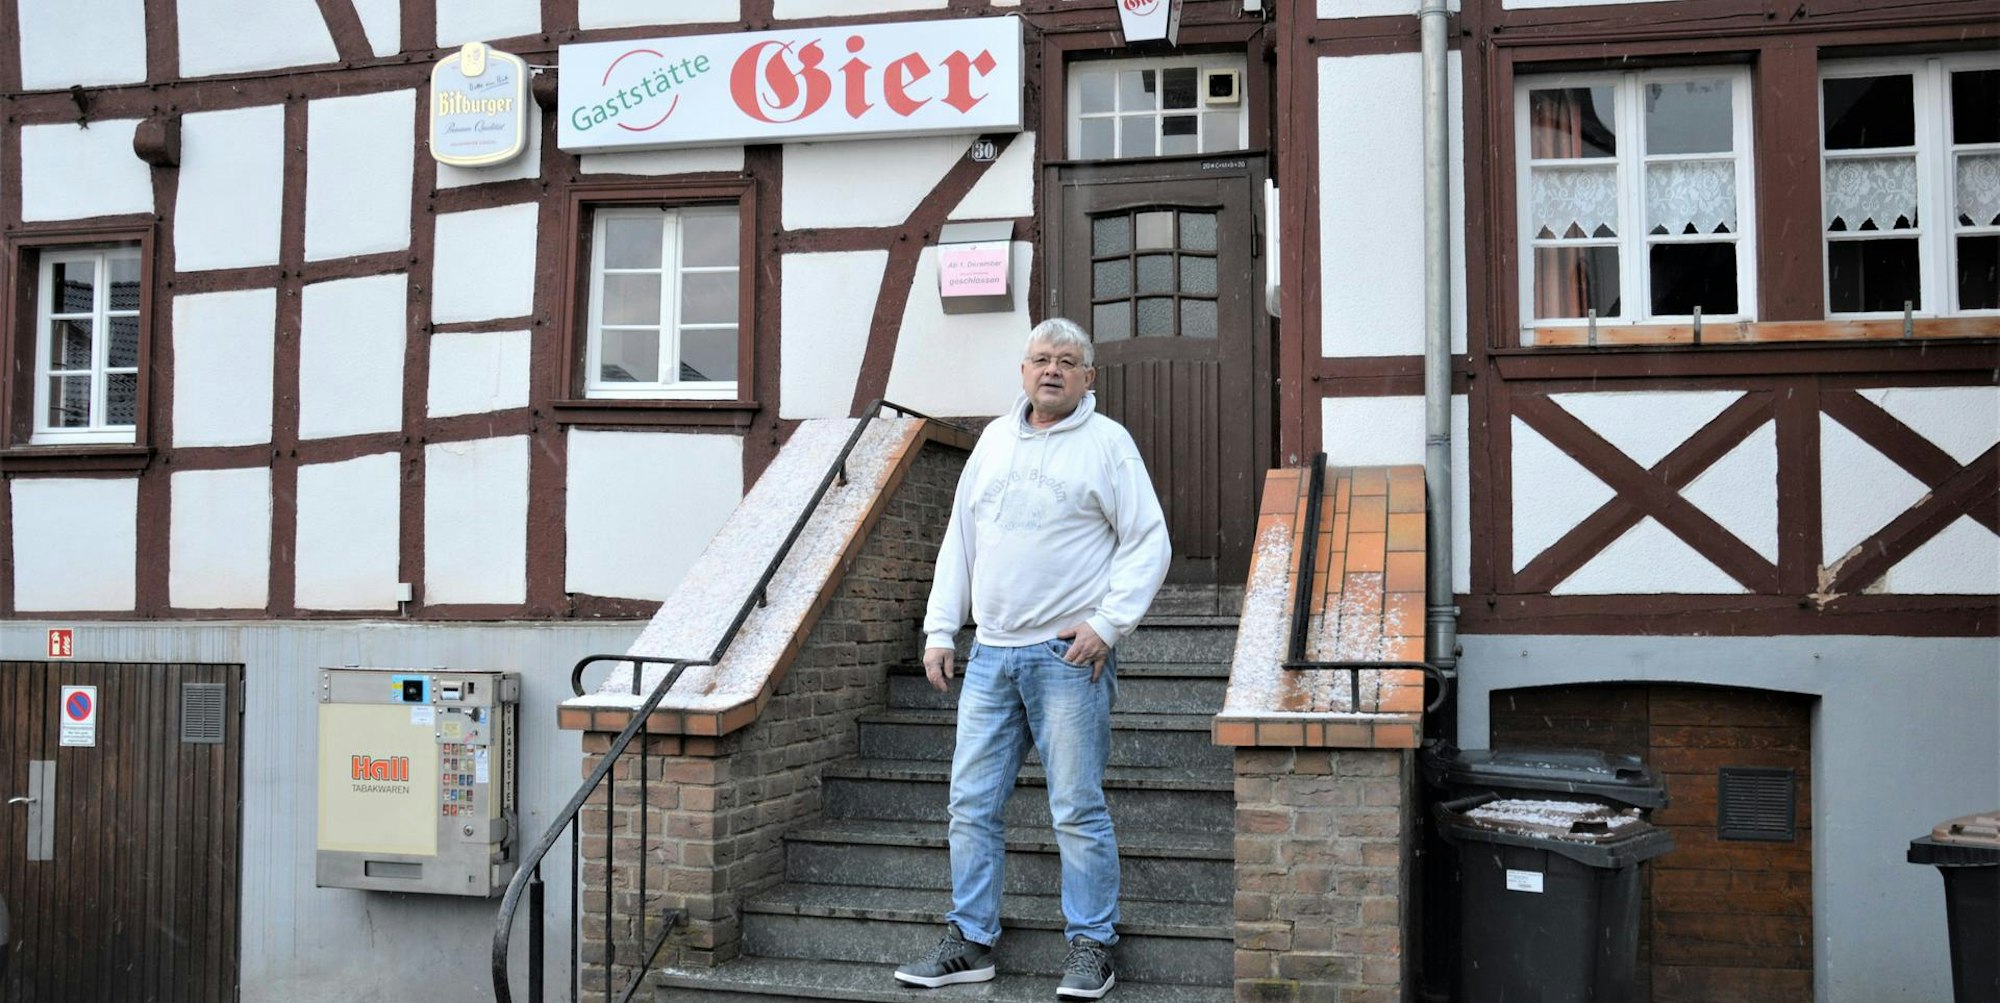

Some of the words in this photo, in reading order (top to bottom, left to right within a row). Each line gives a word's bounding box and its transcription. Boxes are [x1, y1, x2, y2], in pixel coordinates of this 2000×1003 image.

[571, 54, 711, 131] Gaststätte
[729, 35, 997, 123] Gier
[439, 91, 513, 116] Bitburger
[974, 142, 994, 159] 30
[949, 276, 1000, 286] geschlossen
[352, 755, 409, 781] Hall
[352, 784, 409, 794] TABAKWAREN
